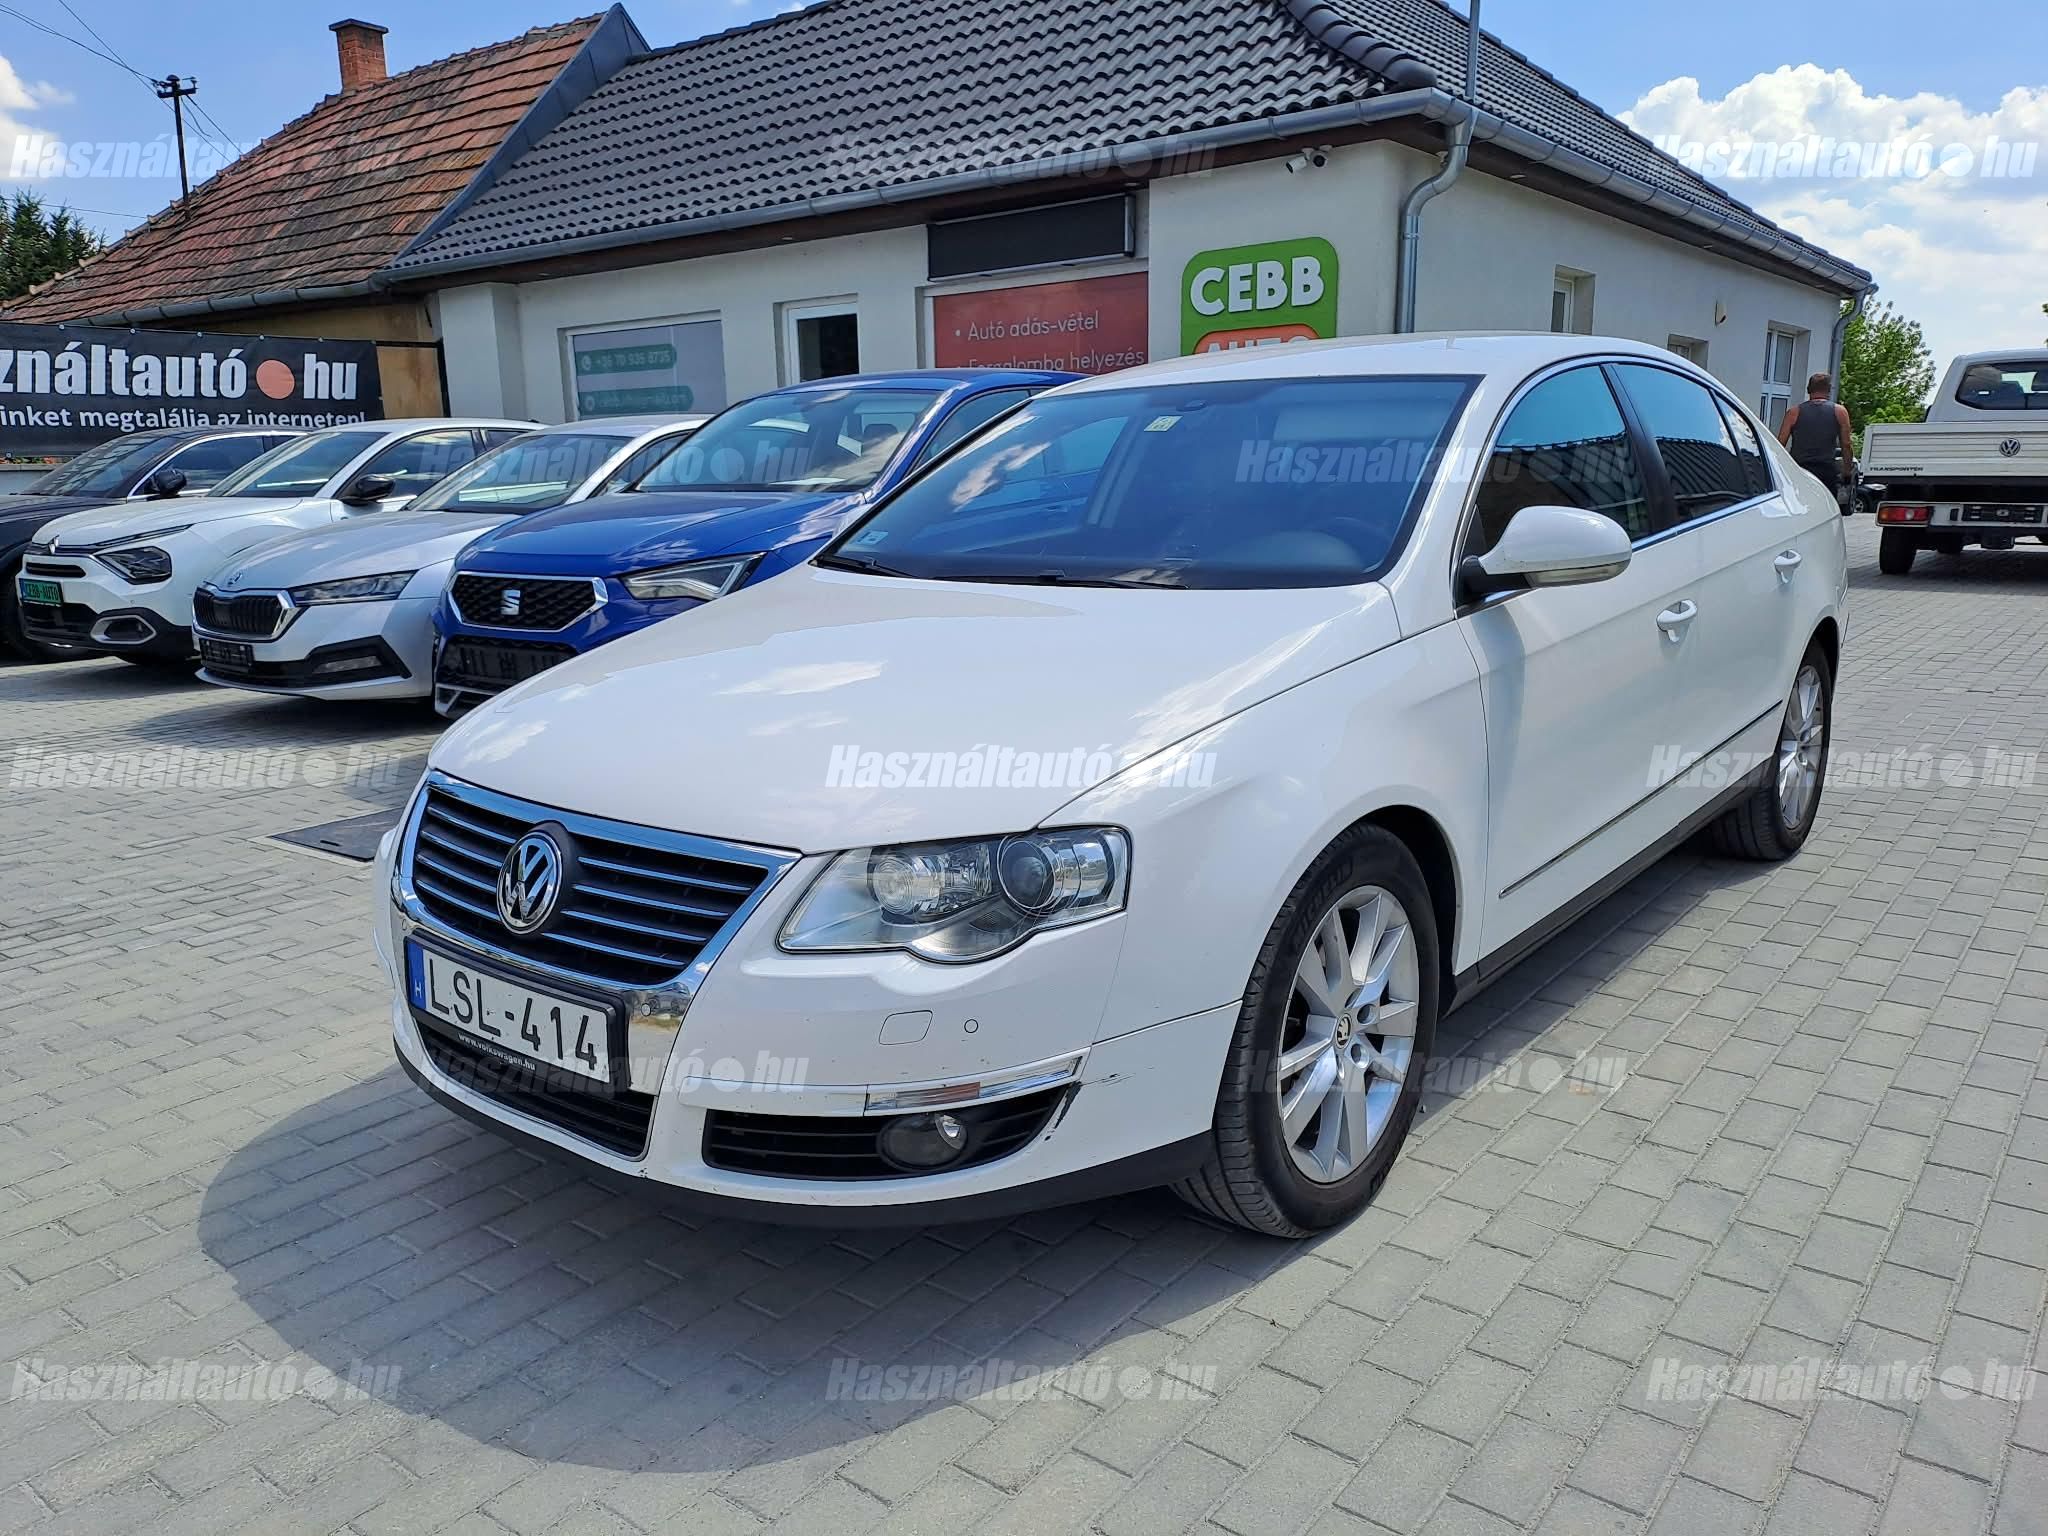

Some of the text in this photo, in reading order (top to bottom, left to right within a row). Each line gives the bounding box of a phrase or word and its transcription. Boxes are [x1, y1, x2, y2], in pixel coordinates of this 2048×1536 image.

[1190, 256, 1325, 316] CEBB
[967, 310, 1099, 341] Autó adás-vétel
[303, 353, 358, 400] hu
[1070, 346, 1145, 373] helyezés
[217, 413, 241, 426] az
[429, 958, 598, 1071] LSL-414
[457, 1033, 536, 1071] www.volkswagen.hu
